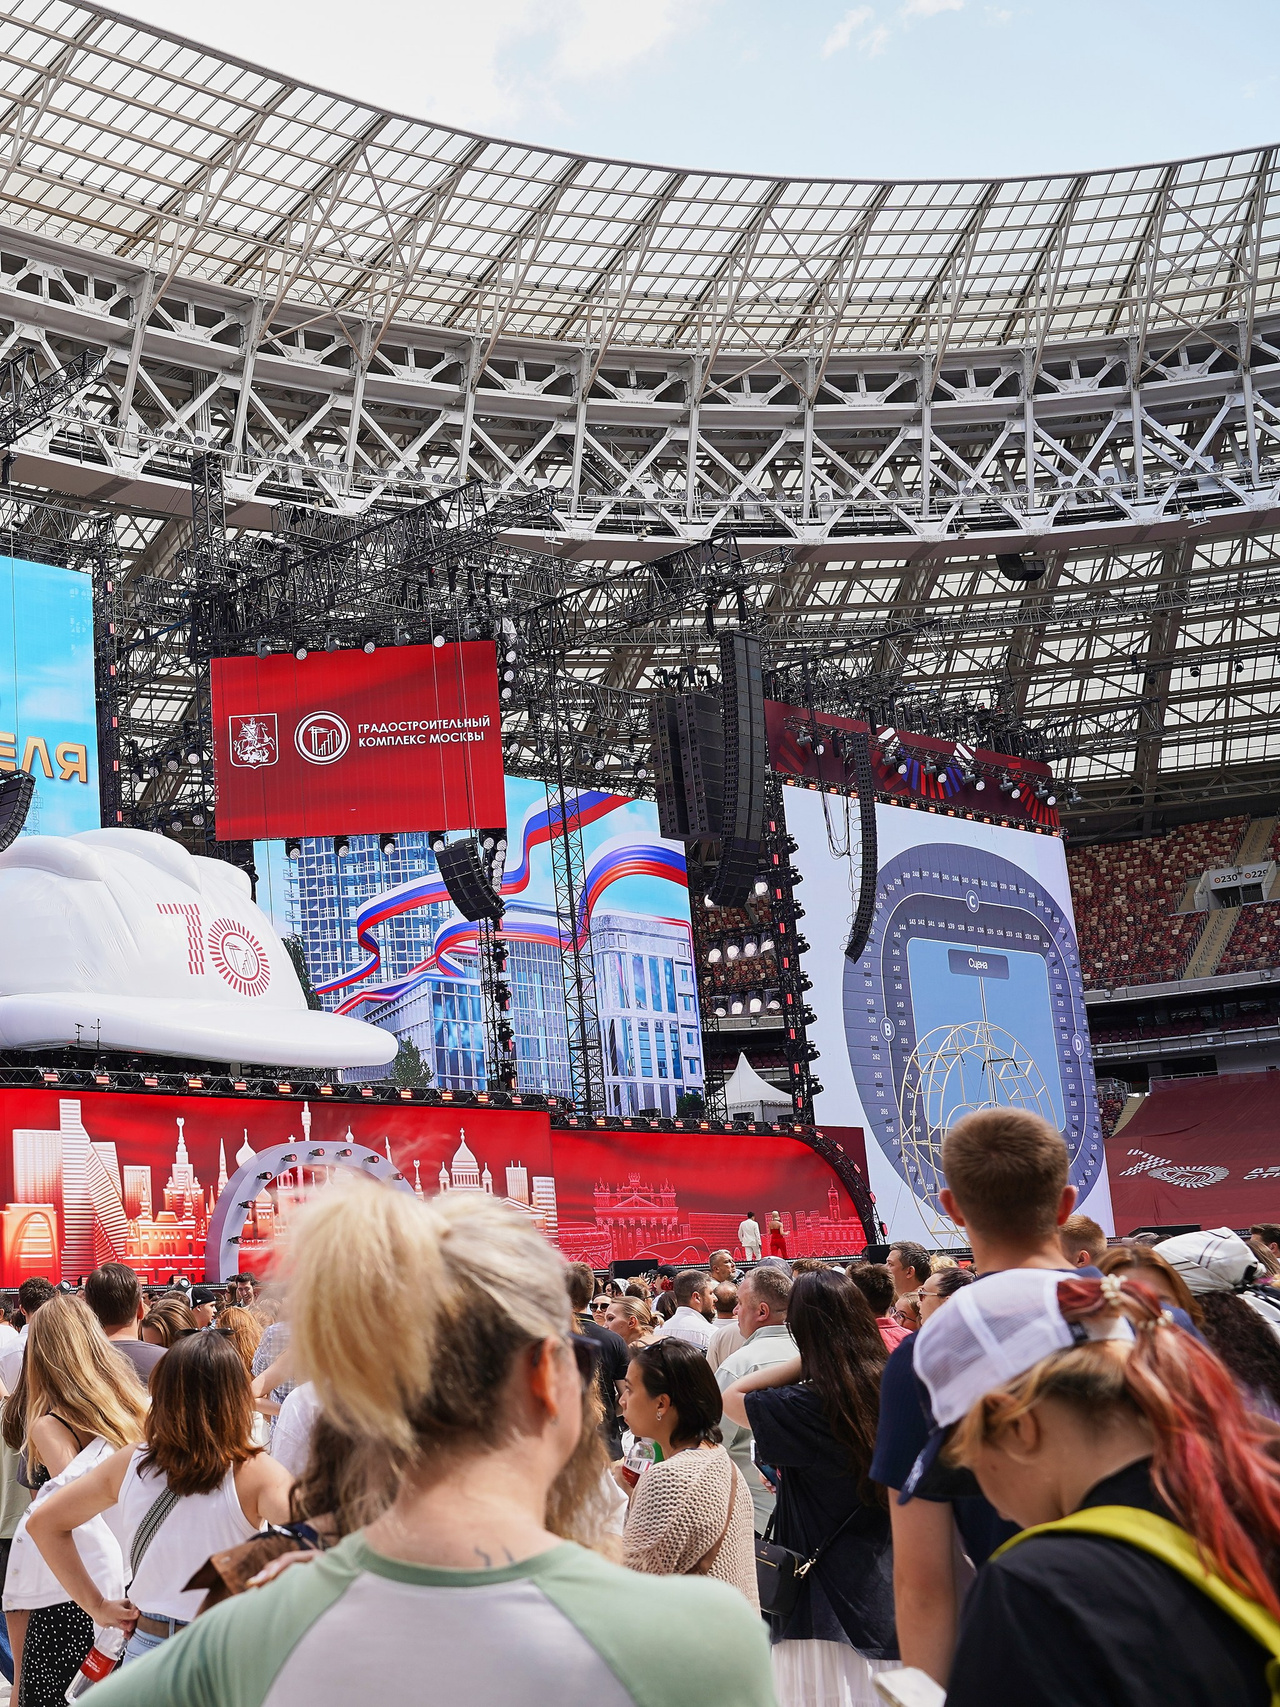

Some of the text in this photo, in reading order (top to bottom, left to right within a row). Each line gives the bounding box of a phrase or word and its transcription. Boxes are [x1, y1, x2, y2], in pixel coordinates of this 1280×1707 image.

[358, 715, 491, 733] ГРАДОСТРОИТЕЛЬНЫЙ
[358, 731, 485, 748] КОМПЛЕКС МОСКВЫ
[1221, 873, 1238, 883] 230
[969, 896, 976, 908] C
[968, 958, 988, 970] Сцена
[884, 1023, 891, 1036] B
[1075, 1039, 1082, 1051] D
